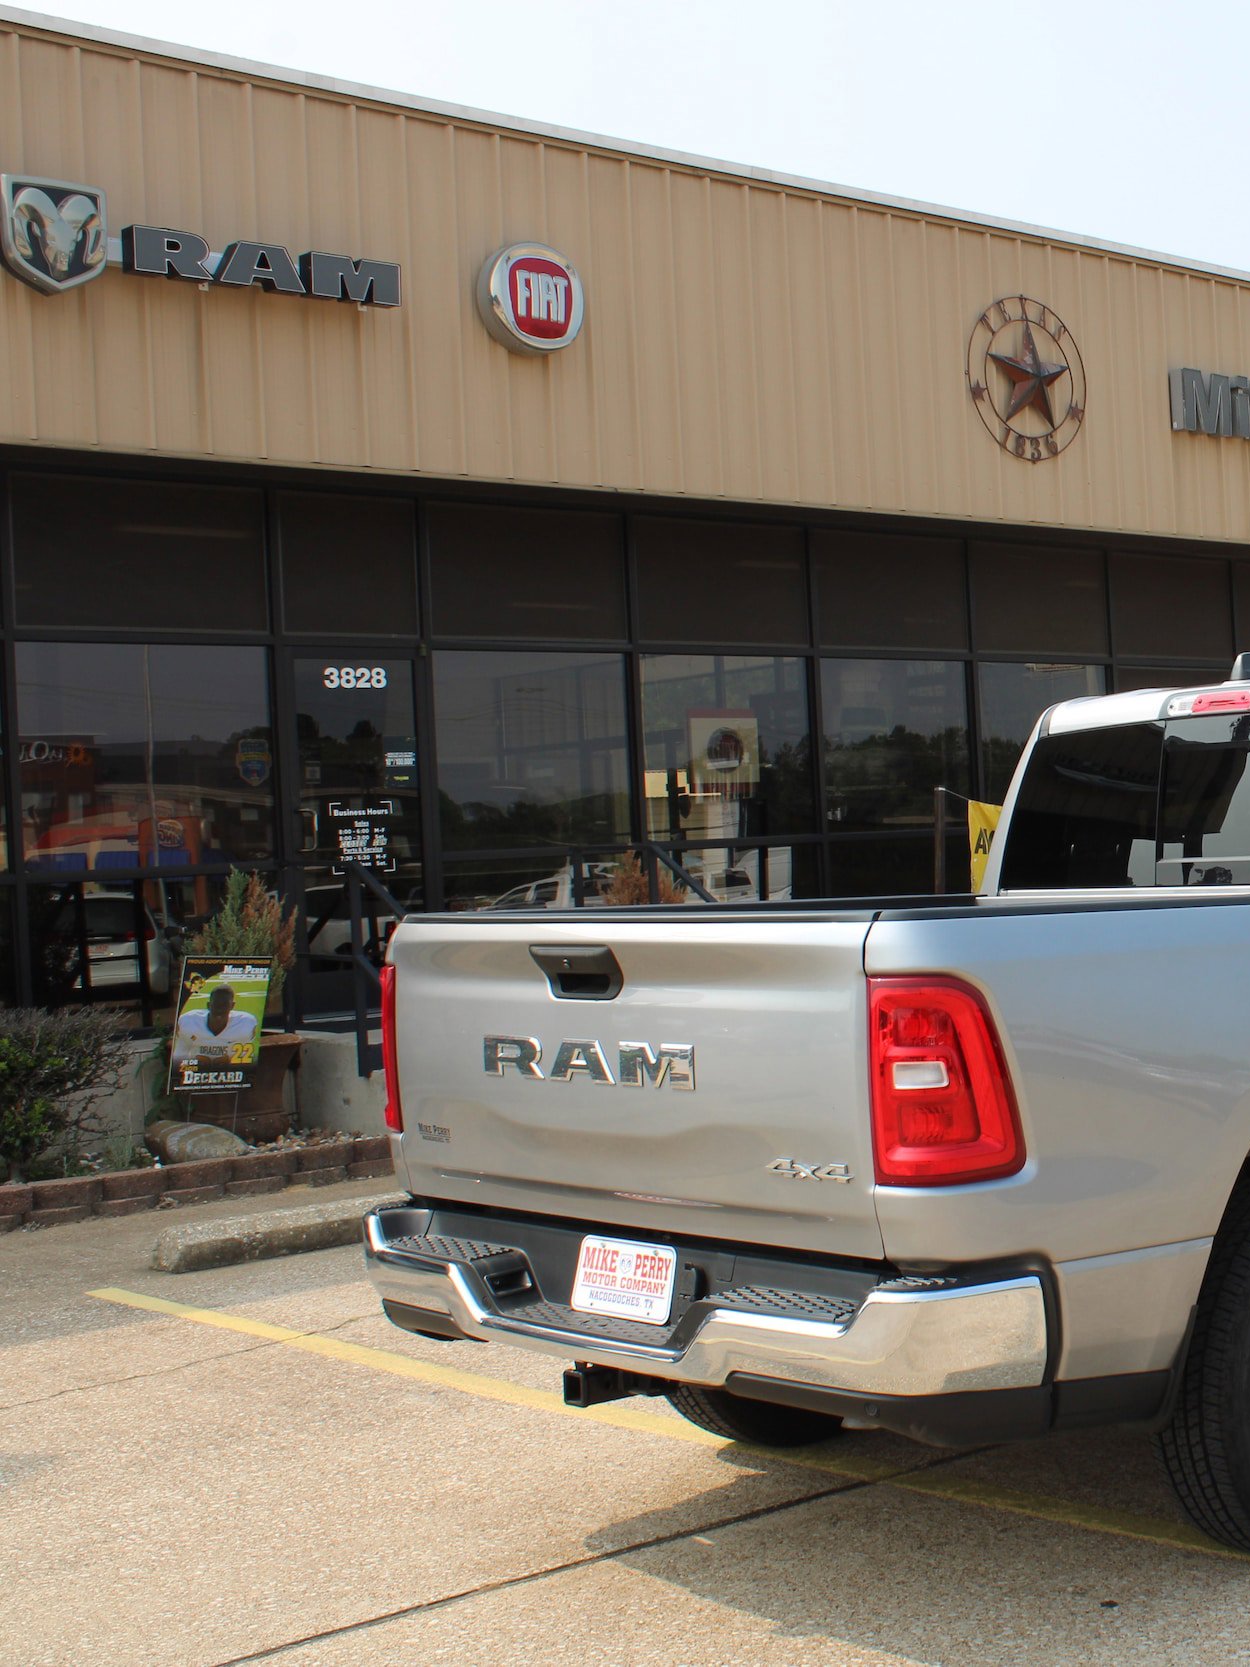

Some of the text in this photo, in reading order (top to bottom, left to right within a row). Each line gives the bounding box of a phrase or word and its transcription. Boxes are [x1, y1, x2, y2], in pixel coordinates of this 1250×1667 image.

[122, 224, 401, 308] RAM
[516, 269, 568, 324] FIAT
[980, 297, 1068, 342] TEXAS
[1000, 426, 1060, 460] 1836
[324, 667, 387, 689] 3828
[333, 808, 389, 817] Business Hours
[200, 1045, 228, 1056] DRAGONS
[231, 1043, 255, 1064] 22
[484, 1034, 696, 1091] RAM
[182, 1071, 243, 1085] DECKARD
[765, 1157, 855, 1184] 4x4
[582, 1246, 672, 1281] MIKE PERRY
[583, 1271, 666, 1296] MOTOR COMPANY
[644, 1298, 654, 1309] TX
